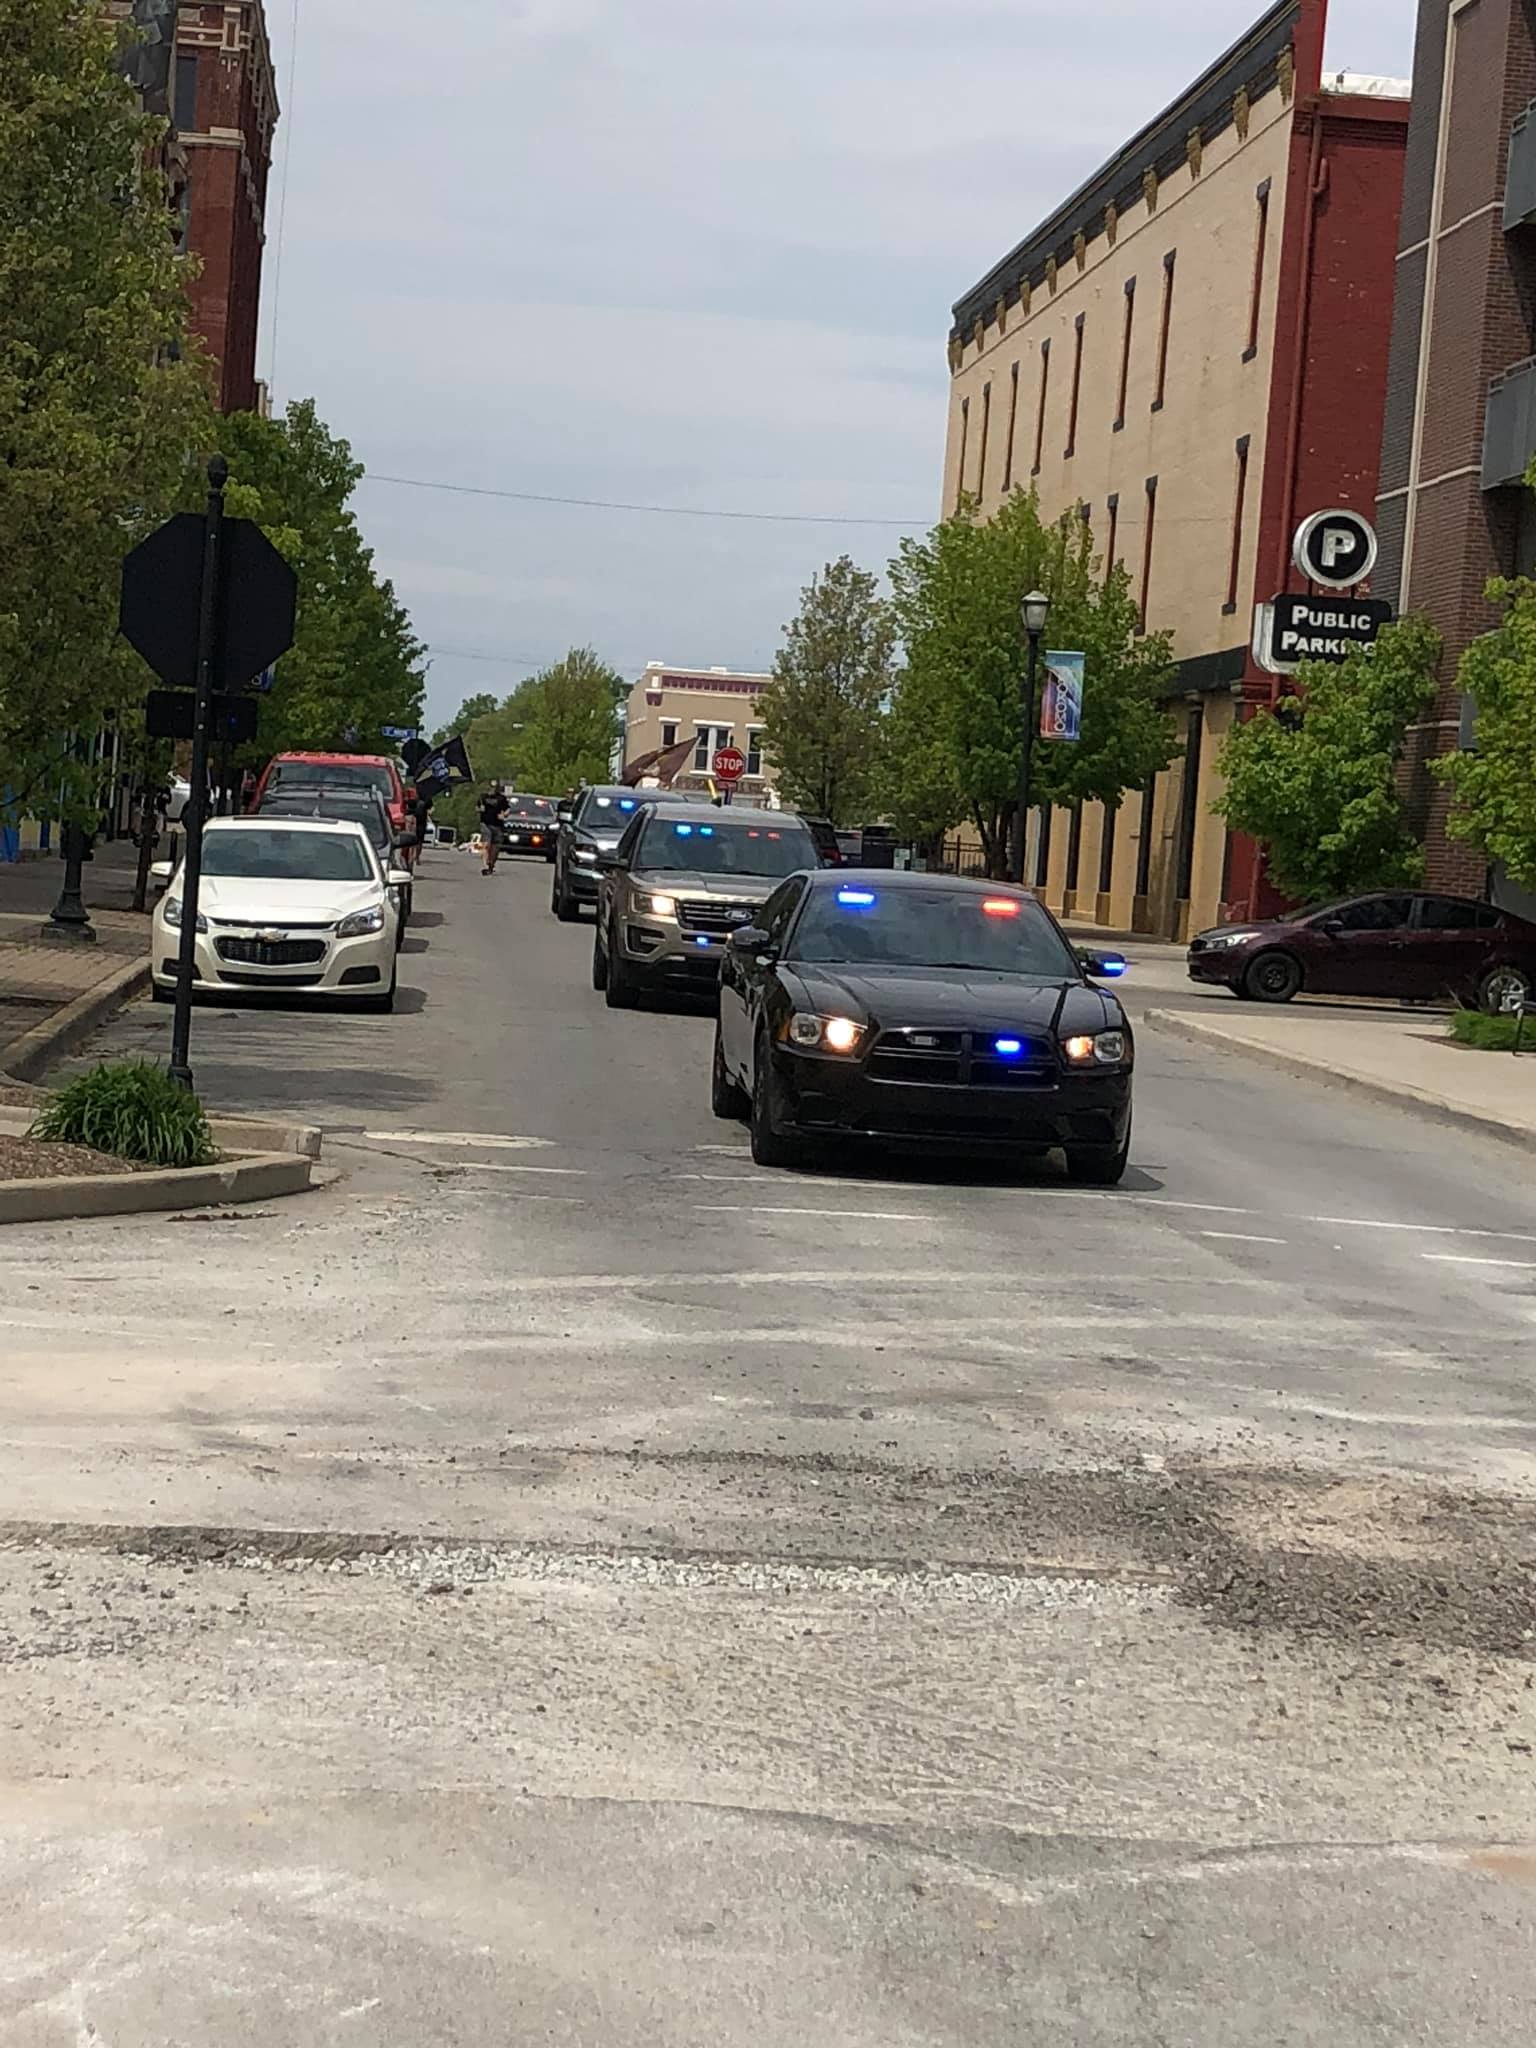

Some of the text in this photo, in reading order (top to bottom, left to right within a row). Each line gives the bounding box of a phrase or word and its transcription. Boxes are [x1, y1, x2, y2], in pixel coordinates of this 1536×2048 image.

[1321, 527, 1356, 567] P
[1291, 604, 1372, 631] PUBLIC
[1281, 630, 1377, 657] PARKIG
[715, 757, 743, 771] STOP
